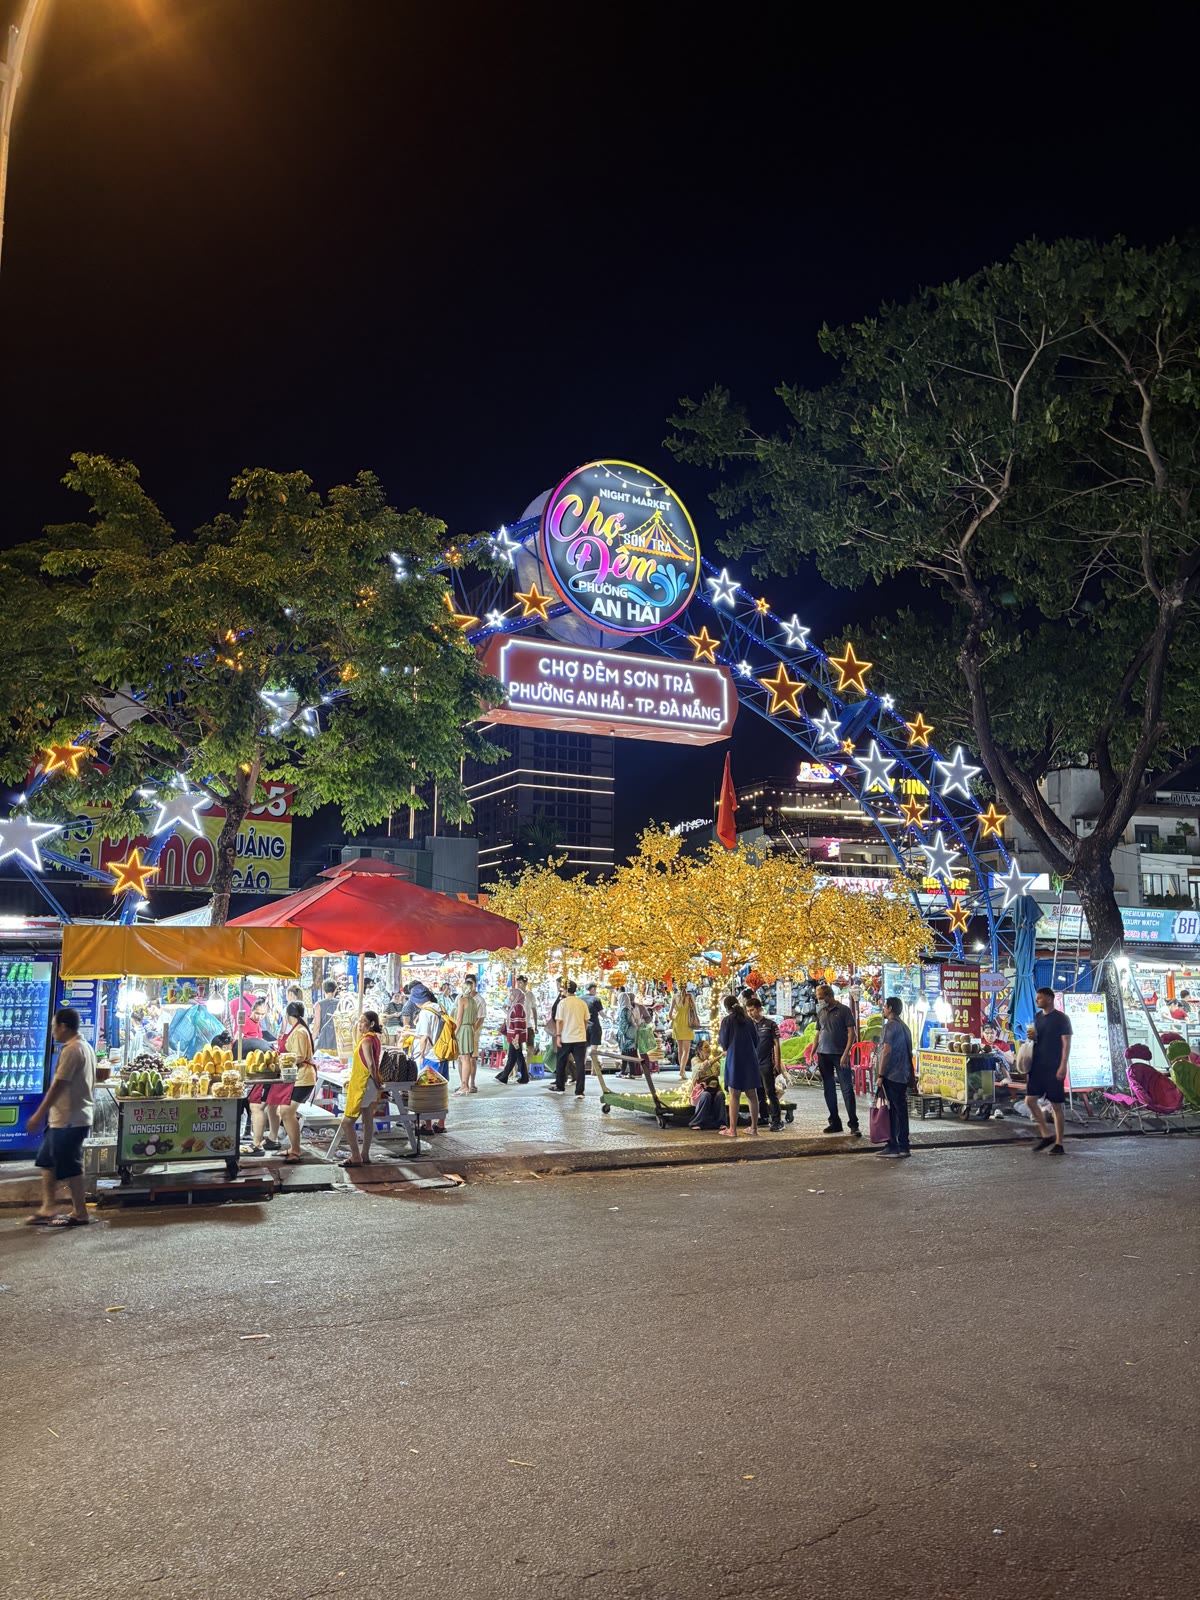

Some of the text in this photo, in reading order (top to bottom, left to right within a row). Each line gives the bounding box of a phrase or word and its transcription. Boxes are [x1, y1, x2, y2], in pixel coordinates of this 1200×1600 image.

[600, 488, 671, 511] NIGHT MARKET
[550, 494, 627, 546] Chợ
[566, 535, 658, 592] Đêm
[578, 581, 628, 598] PHƯỜNG
[591, 597, 621, 619] AN
[538, 658, 695, 694] CHỢ ĐÊM SƠN TRÀ
[509, 681, 573, 704] PHƯỜNG
[576, 692, 599, 708] AN
[601, 690, 625, 710] HẢI
[635, 697, 657, 715] TP.
[659, 697, 681, 717] ĐÀ
[217, 826, 285, 860] UẢNG
[1177, 917, 1198, 935] BH
[197, 1105, 224, 1120] 망고
[130, 1121, 226, 1134] MANGOSTEEN MANGO
